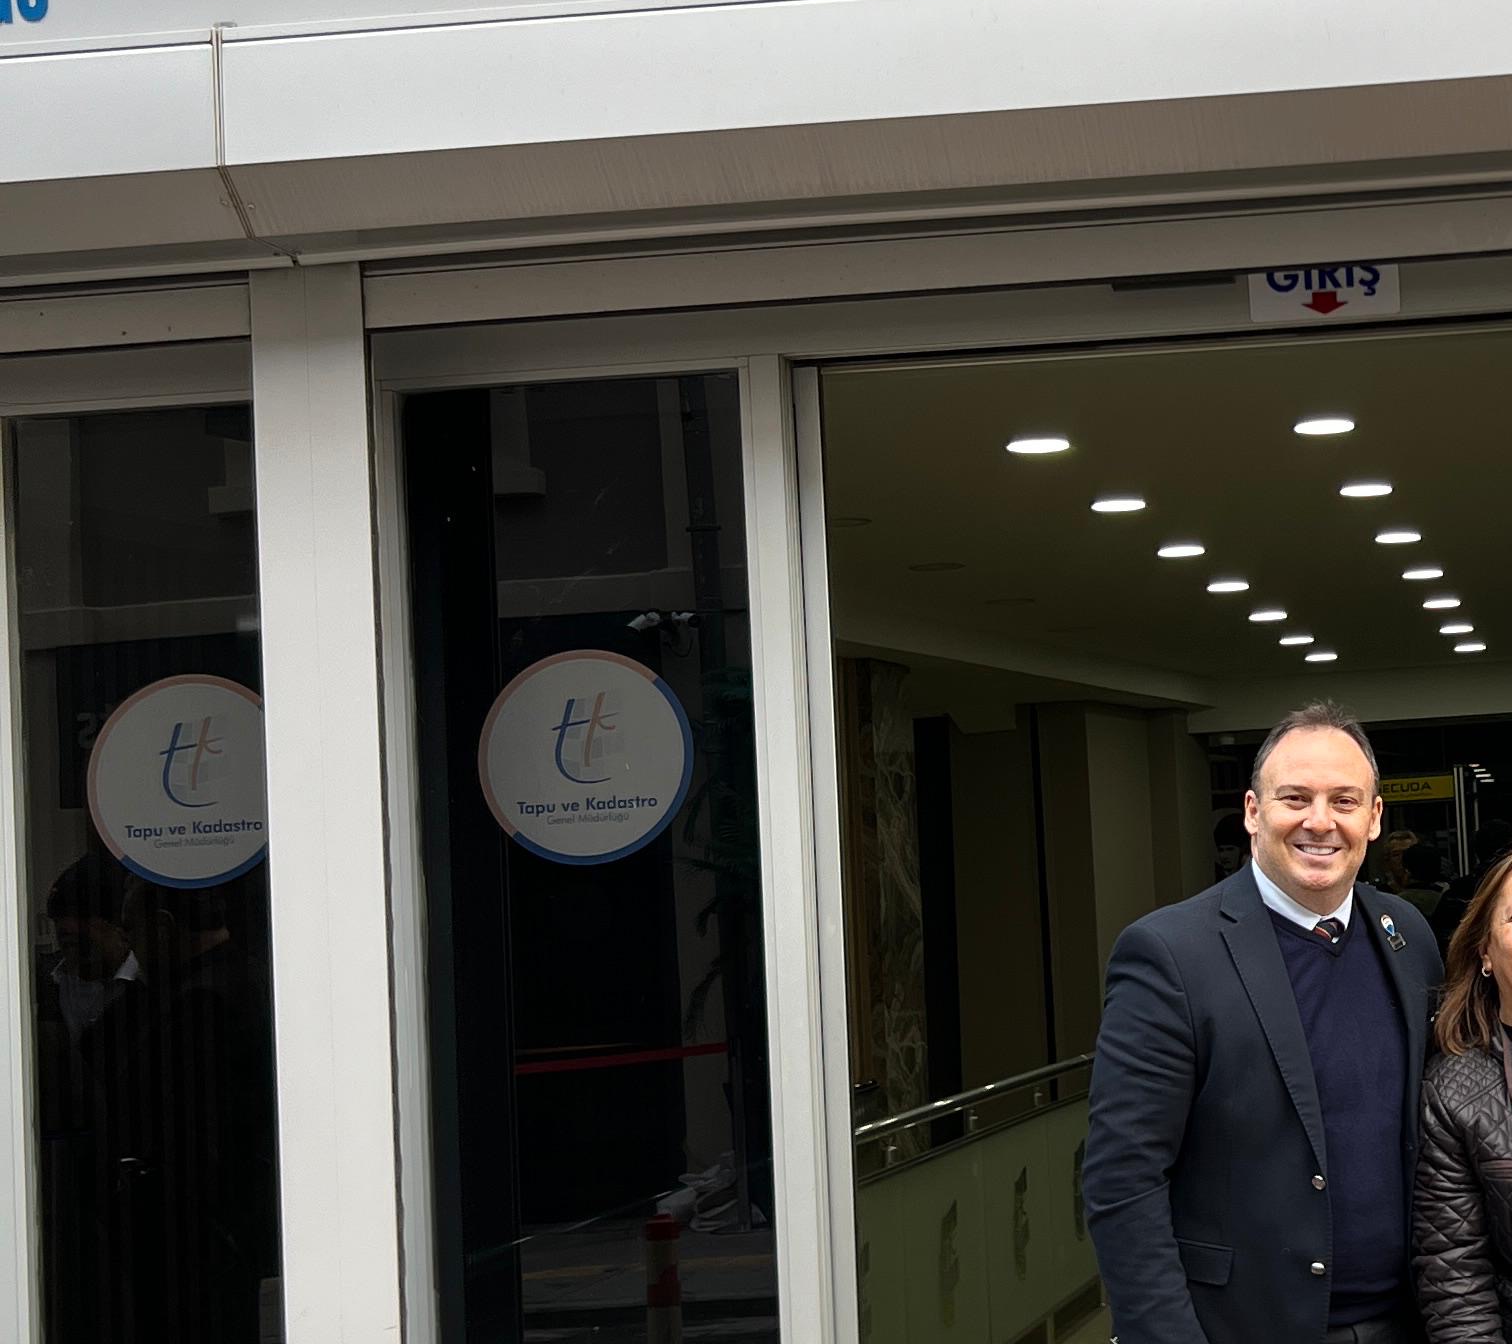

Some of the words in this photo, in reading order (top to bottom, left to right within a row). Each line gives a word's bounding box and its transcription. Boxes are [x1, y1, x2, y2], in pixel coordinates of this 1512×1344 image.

[516, 800, 556, 817] Tapu
[561, 802, 580, 812] ve
[586, 795, 658, 811] Kadastro
[125, 824, 163, 841] Tapu
[168, 824, 186, 835] ve
[192, 819, 263, 834] Kadastro
